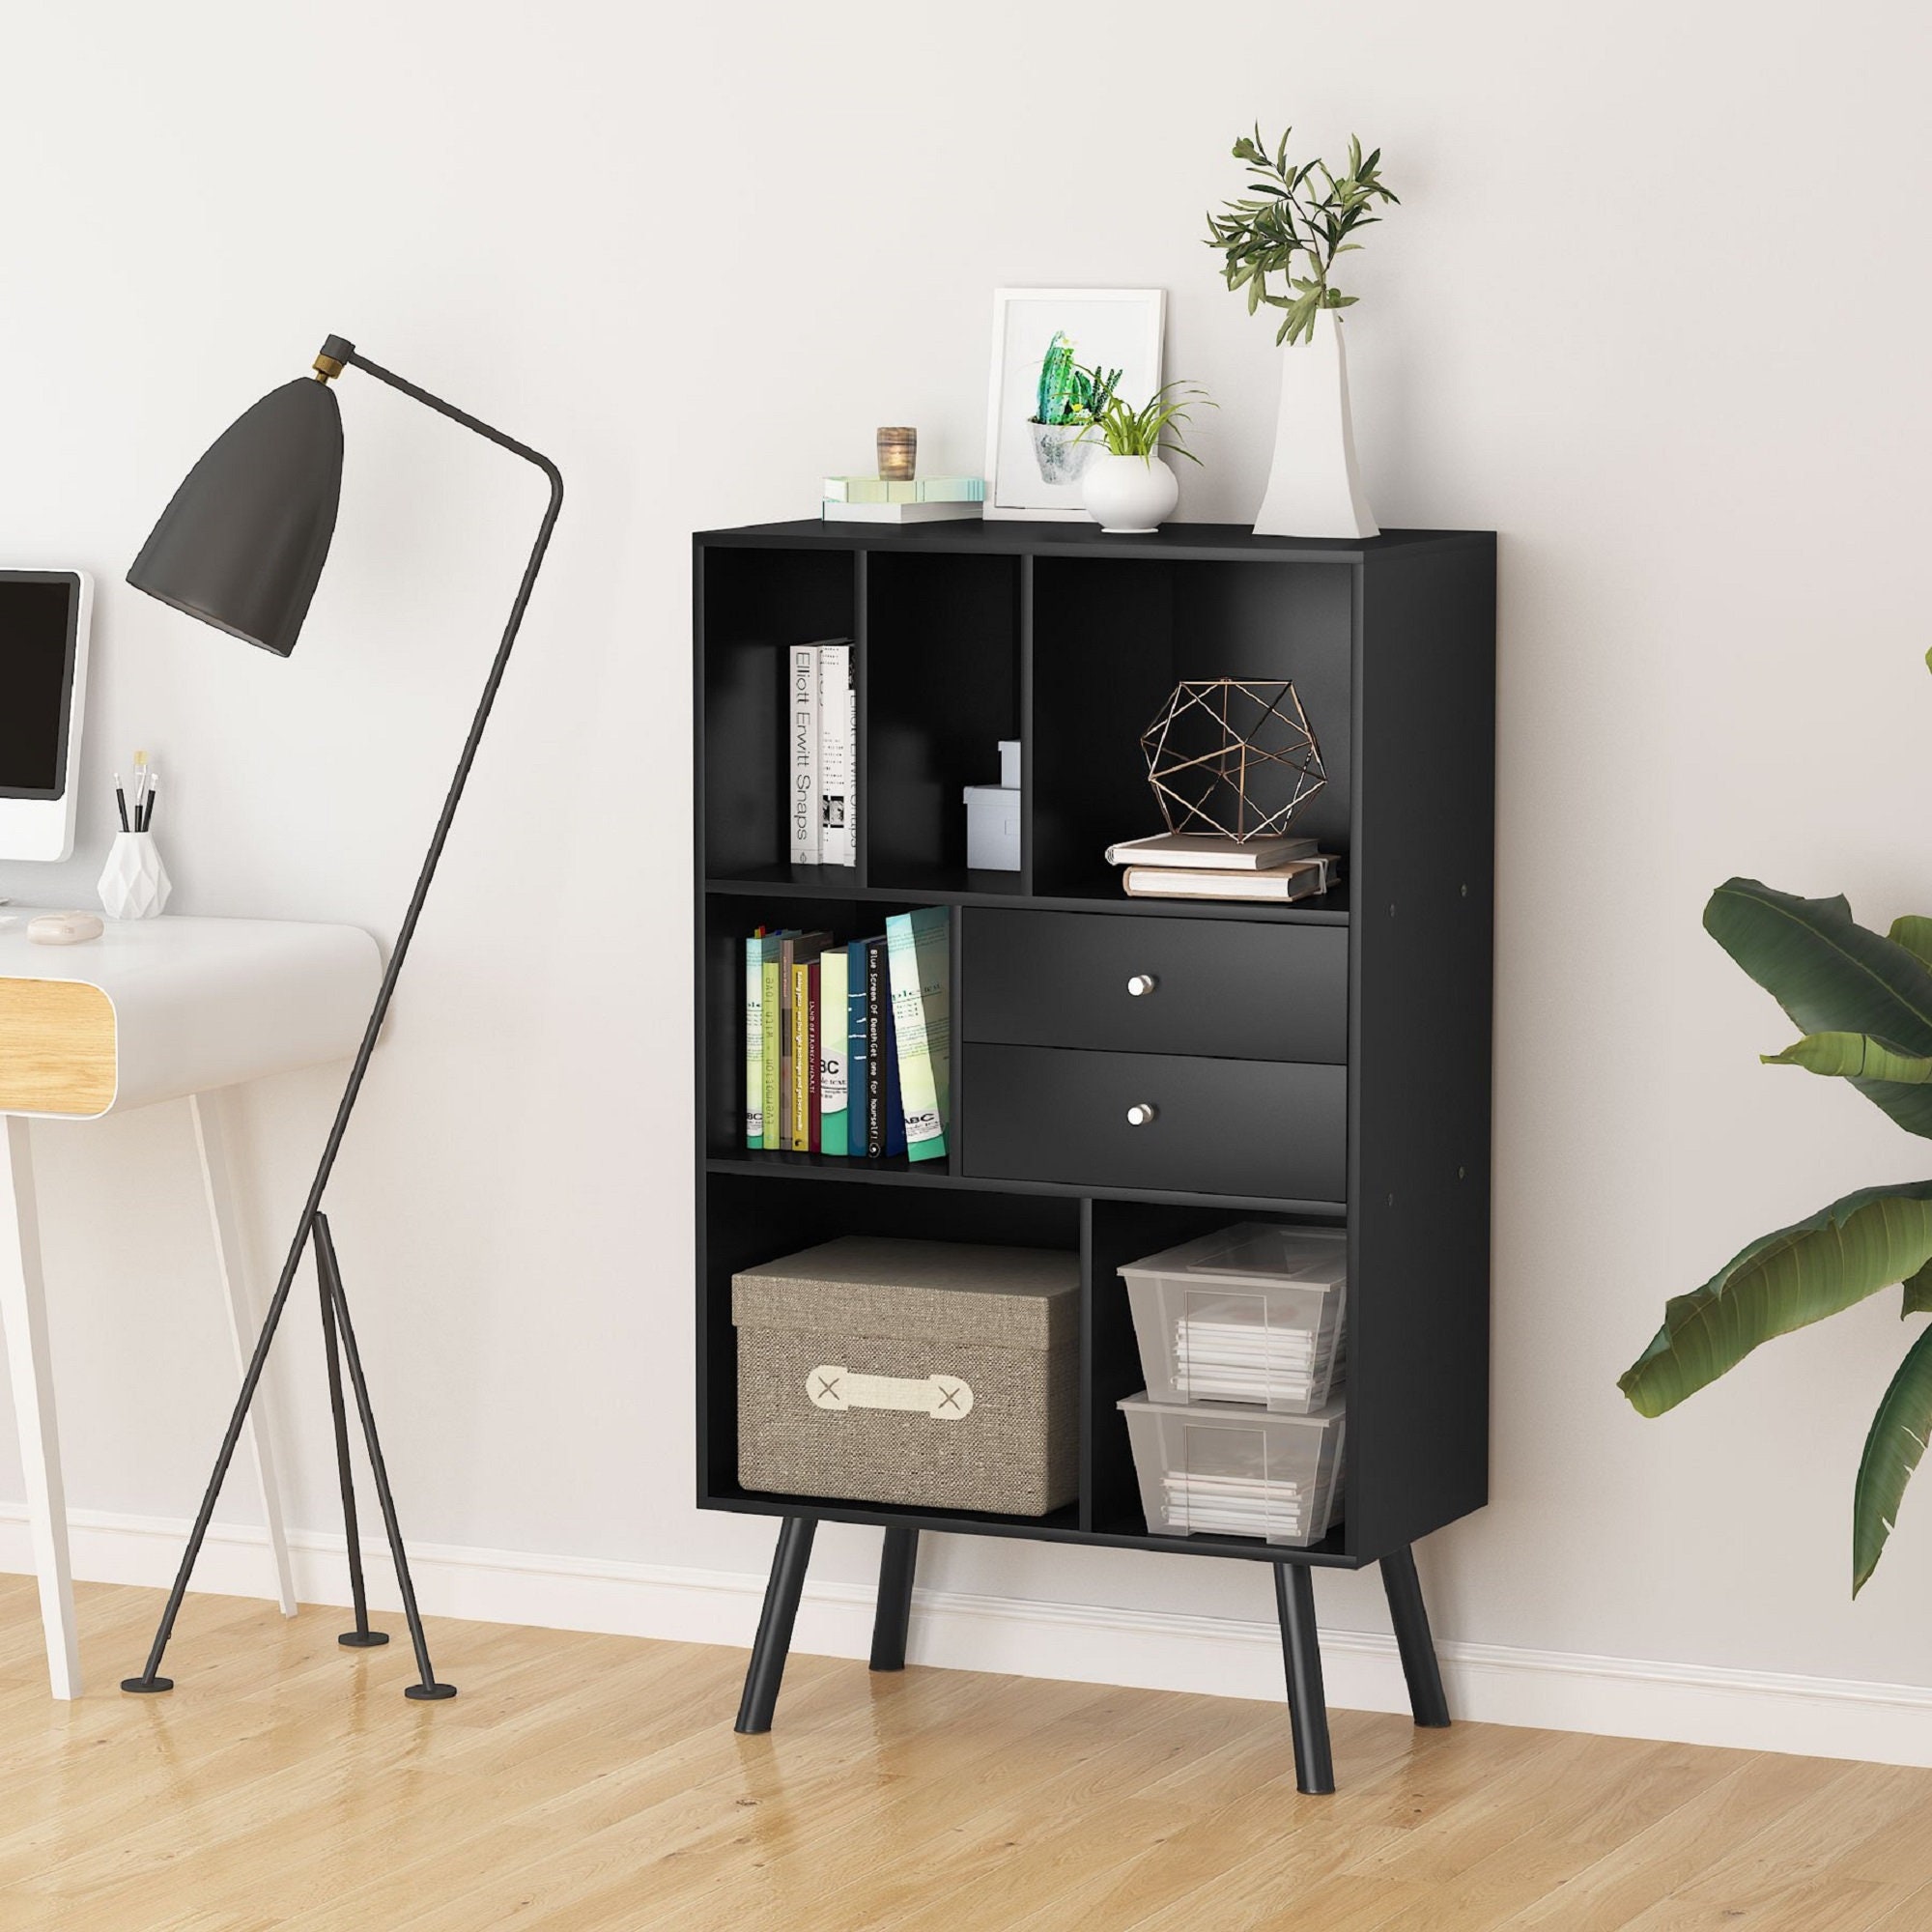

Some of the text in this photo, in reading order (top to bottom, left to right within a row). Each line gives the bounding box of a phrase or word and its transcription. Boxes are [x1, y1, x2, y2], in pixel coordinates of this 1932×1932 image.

[794, 652, 810, 840] Elliott Erwitt Snaps
[869, 949, 878, 969] Blue
[764, 977, 774, 1003] love
[869, 973, 878, 1002] Screen
[869, 1004, 878, 1014] Of
[764, 1012, 774, 1038] with
[869, 1017, 878, 1042] Death
[869, 1043, 878, 1058] Get
[764, 1059, 774, 1125] Evermotion
